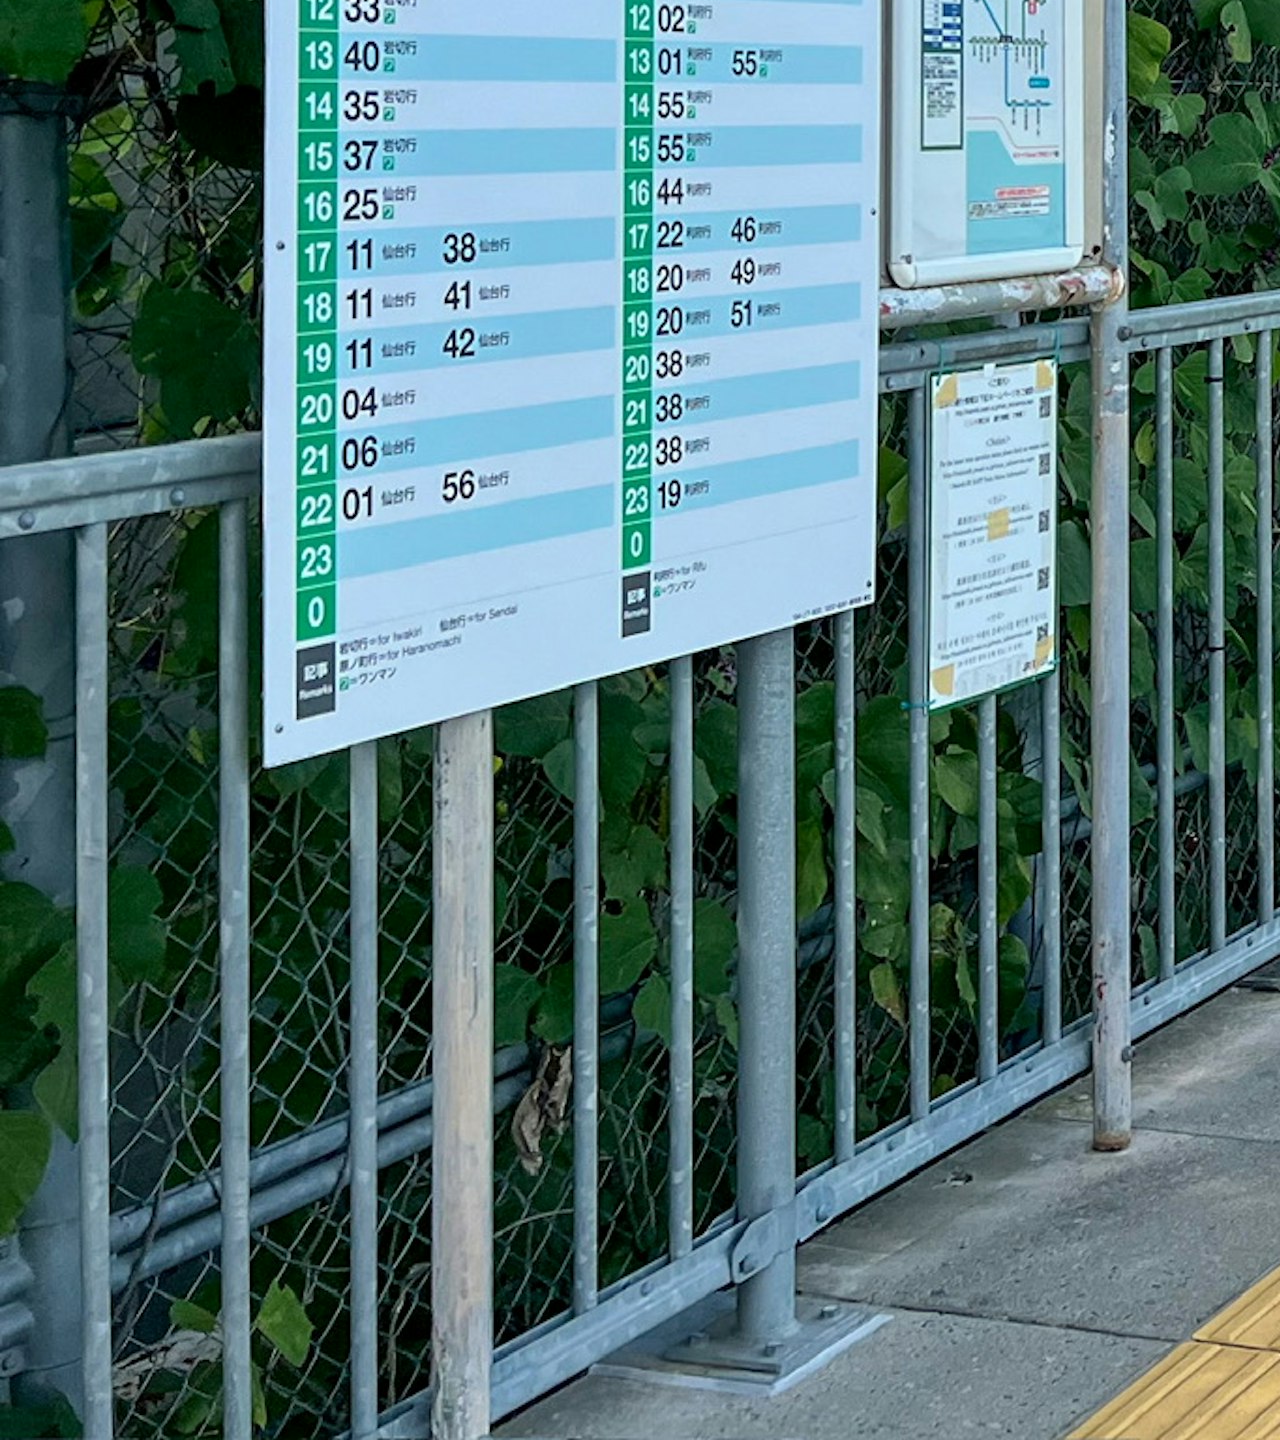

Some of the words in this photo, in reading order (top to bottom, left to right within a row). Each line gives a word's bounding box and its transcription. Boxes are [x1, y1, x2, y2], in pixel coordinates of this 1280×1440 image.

[630, 4, 650, 31] 12
[659, 5, 684, 32] 02
[305, 41, 333, 70] 13
[344, 41, 379, 71] 40
[384, 41, 417, 55] 岩切行
[629, 48, 650, 74] 13
[659, 49, 680, 75] 01
[733, 51, 756, 75] 55
[305, 92, 332, 120] 14
[344, 90, 379, 121] 35
[384, 90, 417, 104] 岩切行
[629, 93, 650, 117] 14
[658, 92, 684, 118] 55
[305, 142, 332, 171] 15
[344, 141, 378, 170] 37
[383, 138, 416, 153] 岩切行
[629, 136, 649, 162] 15
[658, 135, 684, 162] 55
[304, 191, 332, 221] 16
[344, 189, 378, 220] 25
[383, 186, 416, 201] 仙台行
[629, 179, 649, 206] 16
[657, 178, 683, 205] 44
[629, 224, 648, 249] 17
[657, 221, 683, 248] 22
[731, 217, 755, 242] 46
[305, 242, 331, 272] 17
[347, 239, 371, 270] 11
[382, 243, 416, 260] 仙台行
[443, 233, 476, 264] 38
[479, 238, 510, 252] 仙台行
[628, 267, 649, 293] 18
[657, 264, 682, 292] 20
[731, 258, 755, 284] 49
[304, 292, 332, 323] 18
[347, 289, 371, 319] 11
[382, 292, 416, 308] 仙台行
[444, 281, 470, 310] 41
[479, 285, 510, 300] 仙台行
[628, 311, 648, 337] 19
[657, 307, 682, 335] 20
[731, 300, 751, 327] 51
[303, 343, 331, 373] 19
[346, 338, 371, 369] 11
[382, 341, 416, 357] 仙台行
[443, 328, 474, 358] 42
[479, 332, 510, 347] 仙台行
[626, 355, 649, 383] 20
[656, 350, 682, 378] 38
[301, 393, 332, 424] 20
[343, 387, 378, 420] 04
[381, 390, 416, 407] 仙台行
[626, 399, 646, 426] 21
[656, 394, 682, 422] 38
[302, 444, 328, 476] 21
[342, 436, 377, 470] 06
[380, 437, 415, 456] 仙台行
[626, 442, 648, 470] 22
[656, 436, 682, 465] 38
[301, 493, 332, 527] 22
[343, 486, 372, 520] 01
[381, 486, 415, 506] 仙台行
[443, 470, 474, 502] 56
[478, 471, 509, 489] 仙台行
[626, 486, 648, 515] 23
[658, 480, 680, 508] 19
[631, 531, 642, 557] 0
[301, 544, 332, 578] 23
[308, 596, 324, 627] 0
